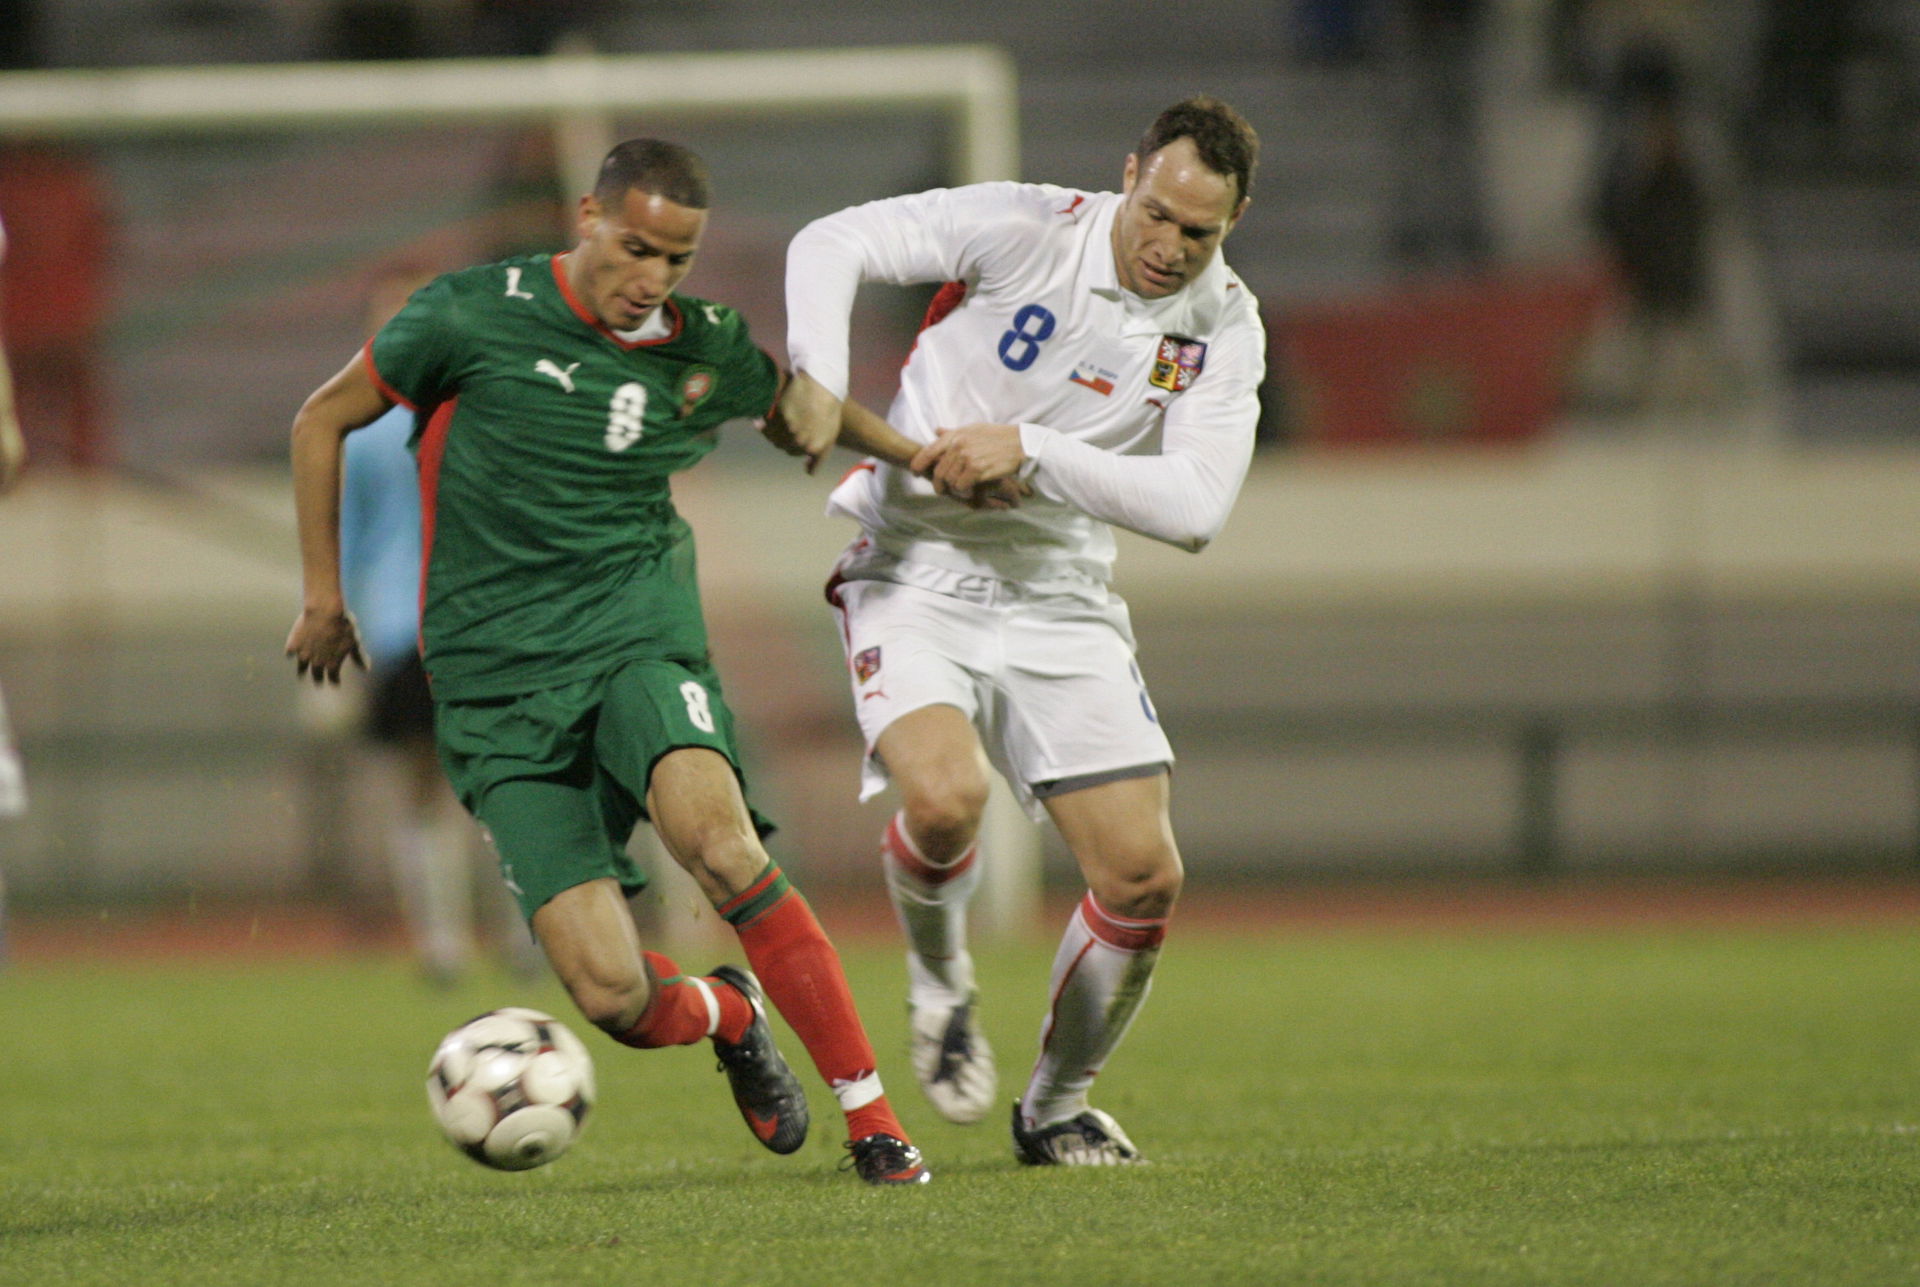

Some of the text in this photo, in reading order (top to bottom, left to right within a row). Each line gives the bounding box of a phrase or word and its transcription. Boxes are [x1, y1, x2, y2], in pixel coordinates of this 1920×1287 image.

[998, 304, 1056, 372] 8
[604, 382, 648, 452] 8
[679, 680, 715, 733] 8
